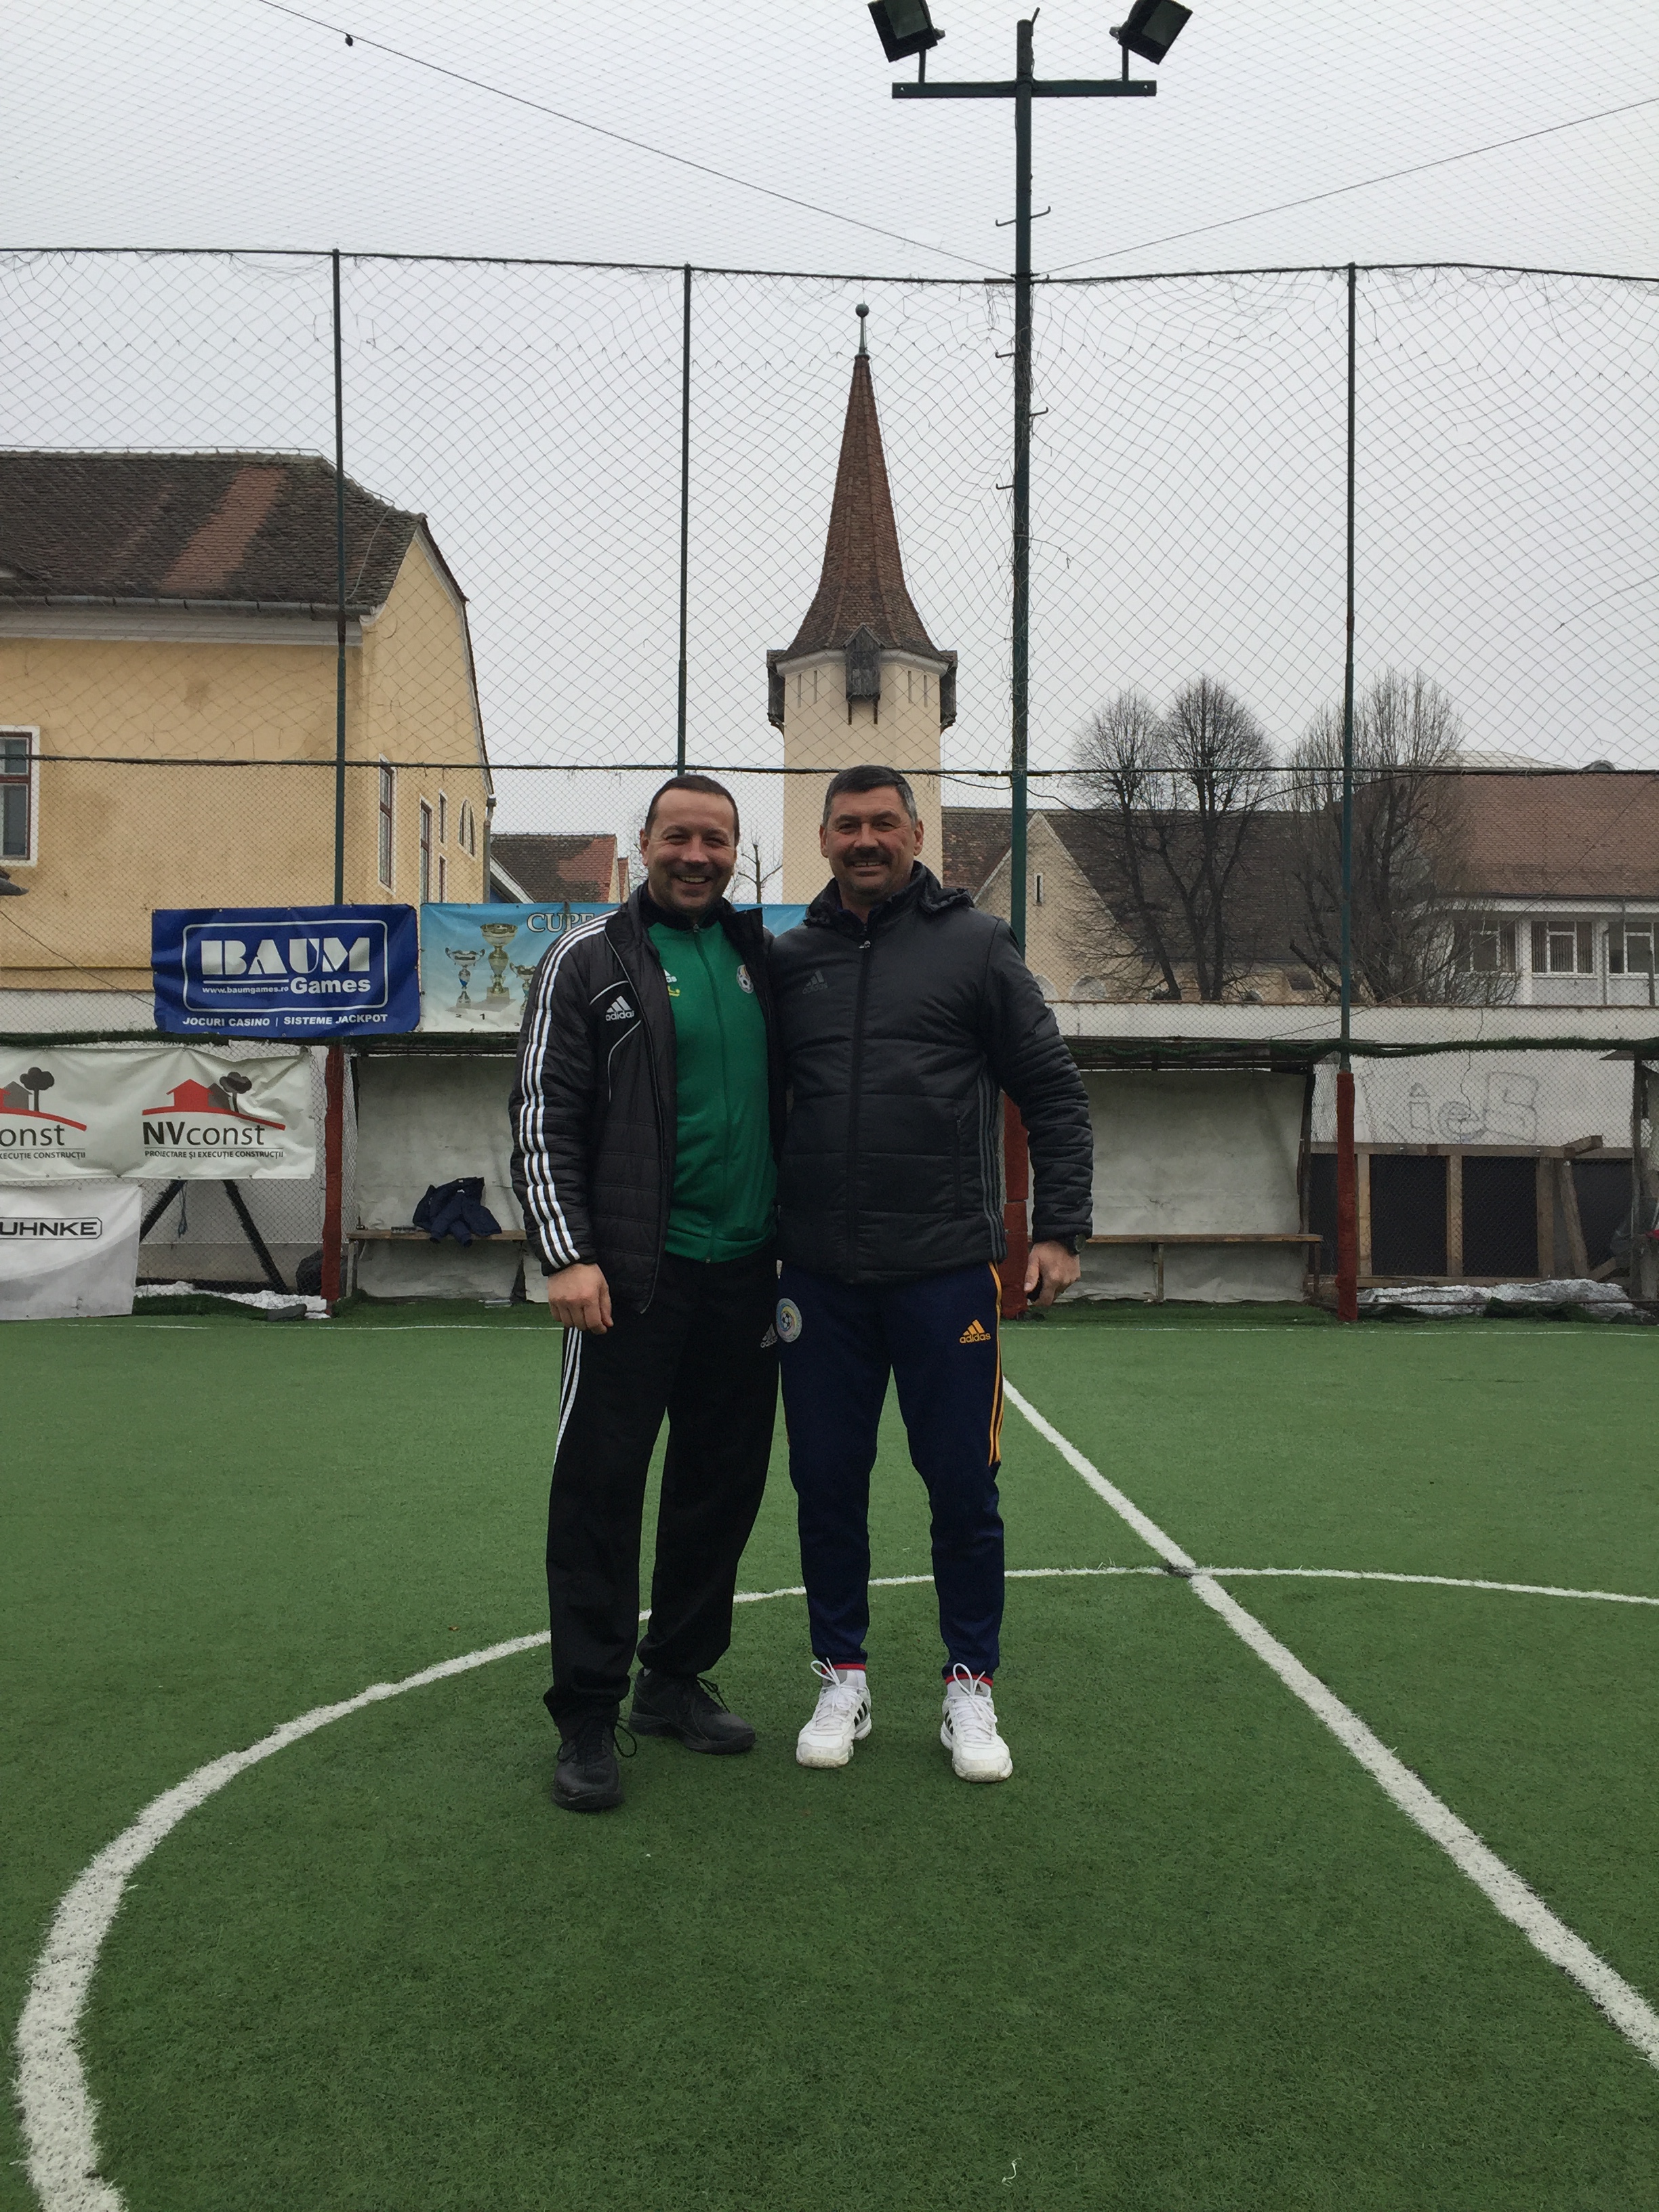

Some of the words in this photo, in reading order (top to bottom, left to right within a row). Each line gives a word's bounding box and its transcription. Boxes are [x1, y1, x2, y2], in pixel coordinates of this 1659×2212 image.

[201, 937, 370, 975] BAUM
[202, 985, 289, 994] www.baumgames.ro
[290, 977, 371, 994] Games
[182, 1017, 225, 1026] JOCURI
[228, 1018, 270, 1026] CASINO
[283, 1017, 332, 1025] SISTEME
[335, 1014, 388, 1024] JACKPOT
[605, 1010, 634, 1021] adidas
[142, 1122, 265, 1145] NVconst
[144, 1150, 187, 1158] PROIECTARE
[0, 1222, 98, 1236] UHNKE
[959, 1333, 991, 1343] adidas
